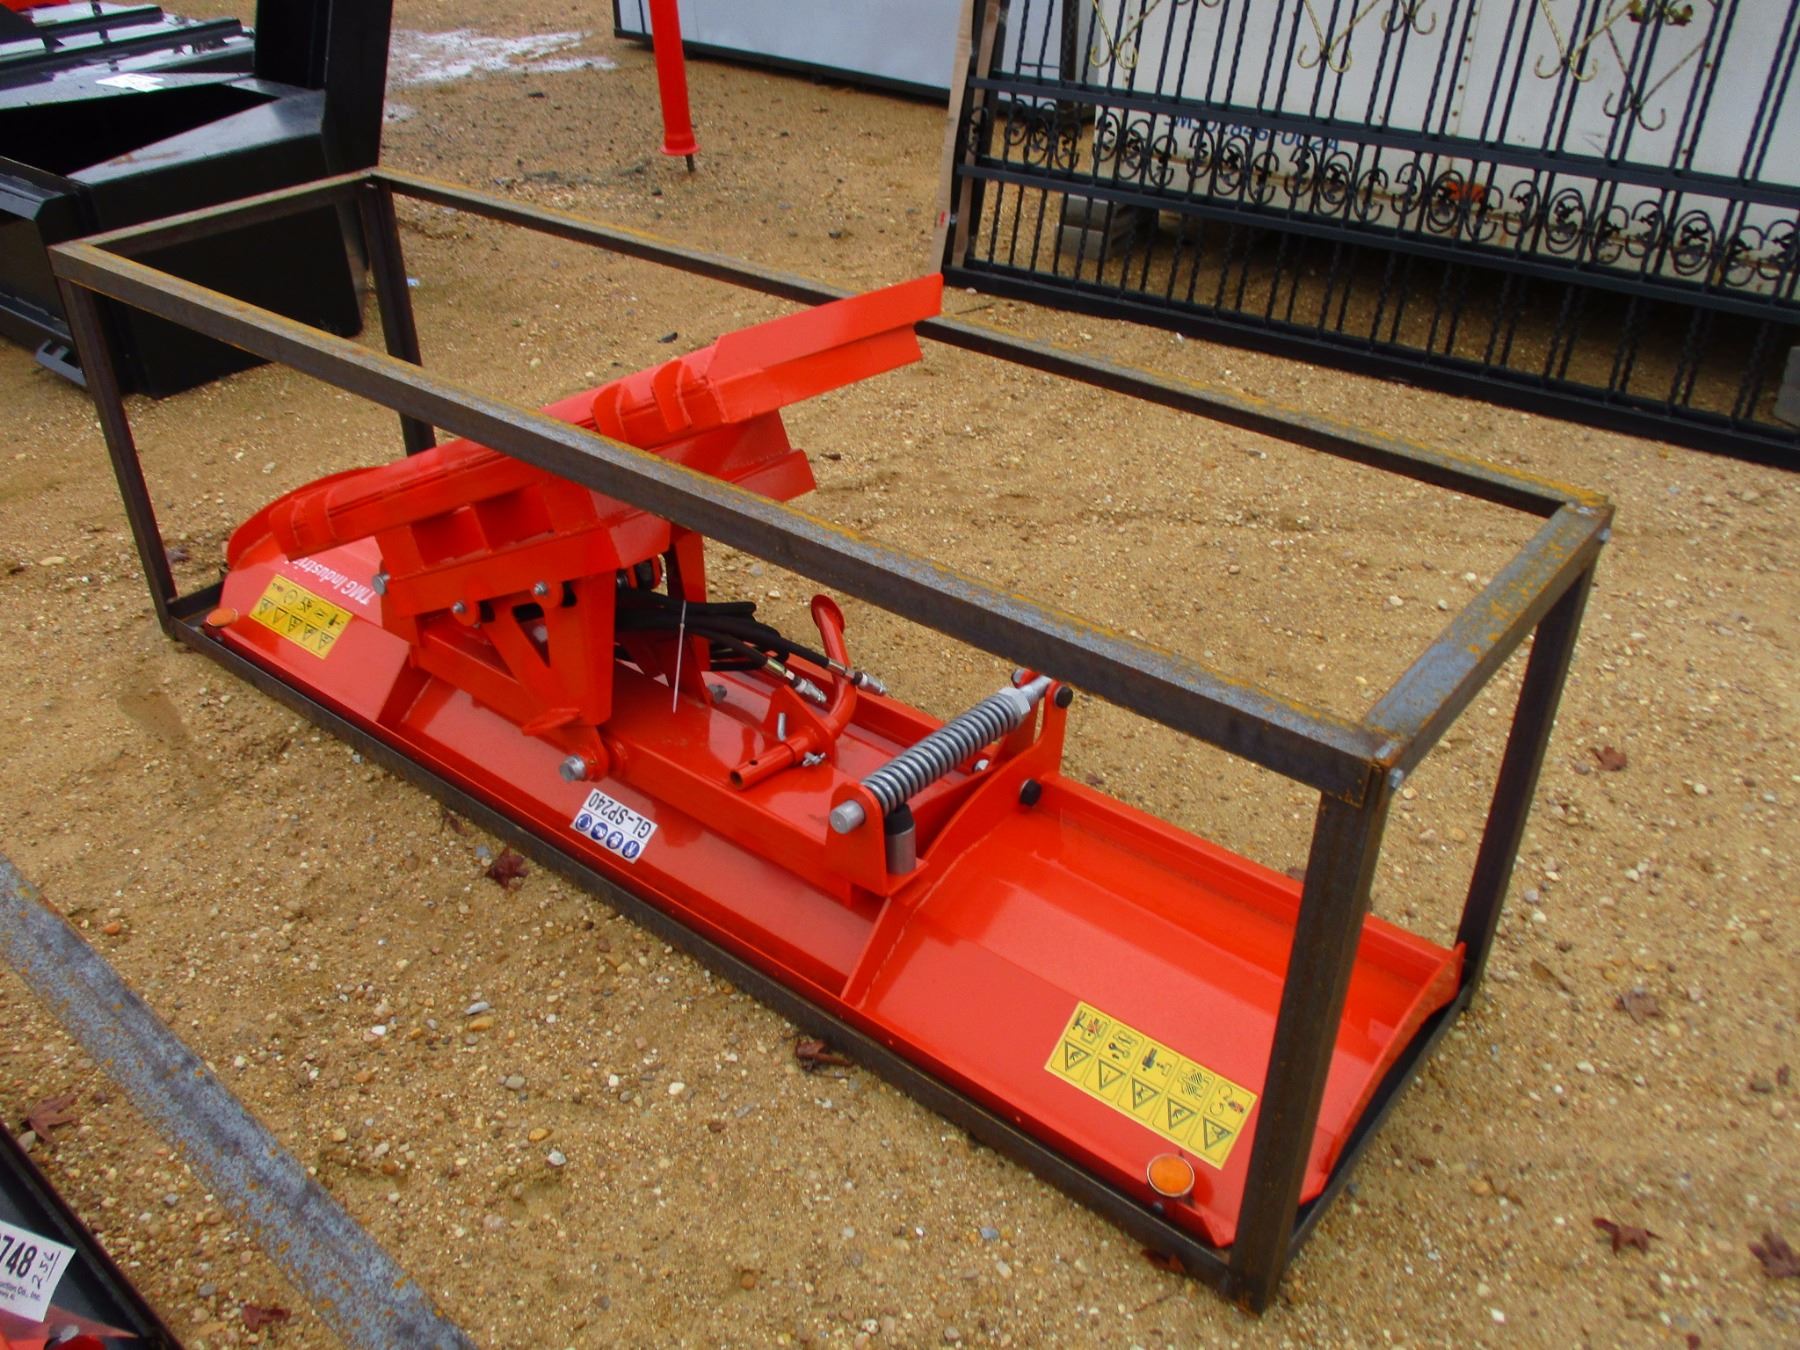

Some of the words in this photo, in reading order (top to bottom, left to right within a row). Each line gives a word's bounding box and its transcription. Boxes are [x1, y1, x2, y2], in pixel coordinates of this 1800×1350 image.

[284, 557, 348, 589] Industri
[341, 580, 376, 605] TMG
[588, 792, 652, 839] GL-SP240
[0, 1234, 37, 1278] 748
